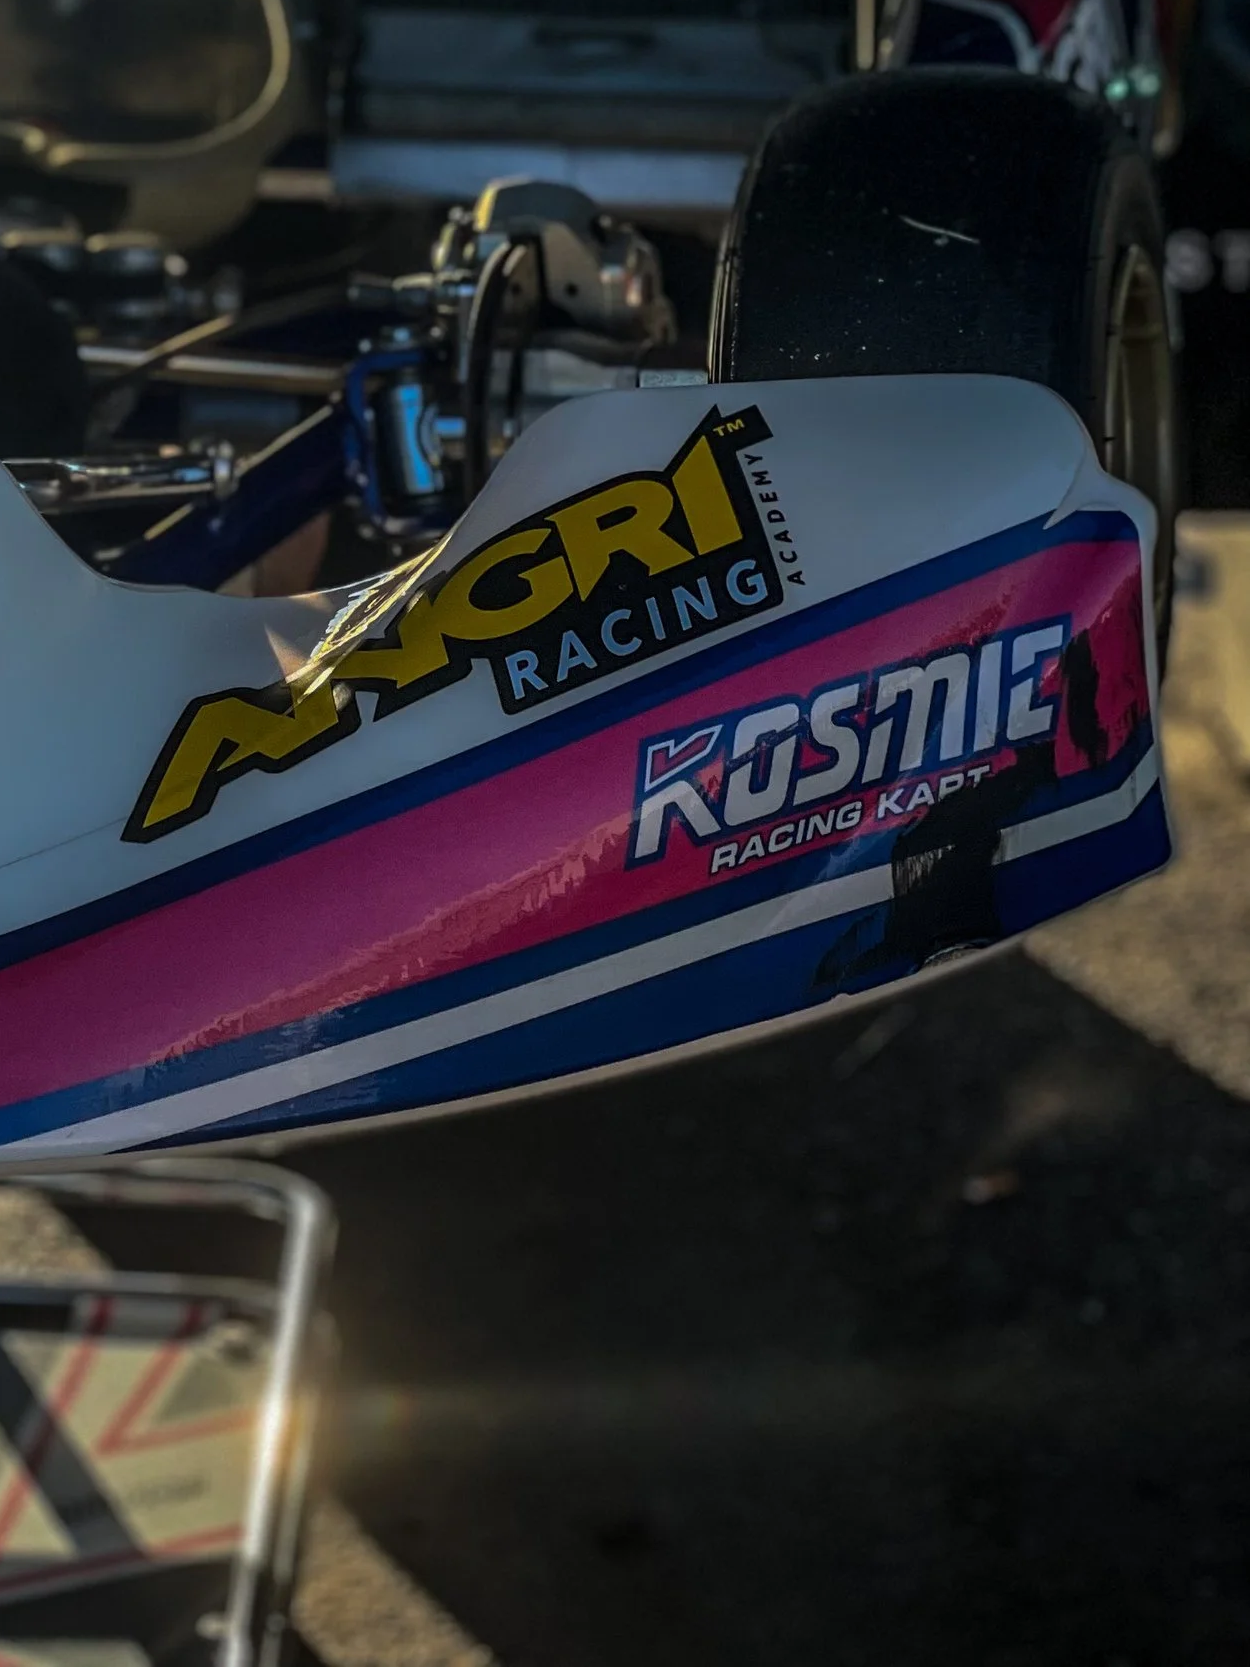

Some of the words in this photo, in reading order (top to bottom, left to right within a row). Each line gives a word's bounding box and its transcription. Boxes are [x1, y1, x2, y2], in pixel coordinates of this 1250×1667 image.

[745, 452, 806, 586] ACADEMY
[142, 434, 743, 828] ANGRI
[505, 557, 769, 701] RACING
[710, 799, 864, 875] RACING
